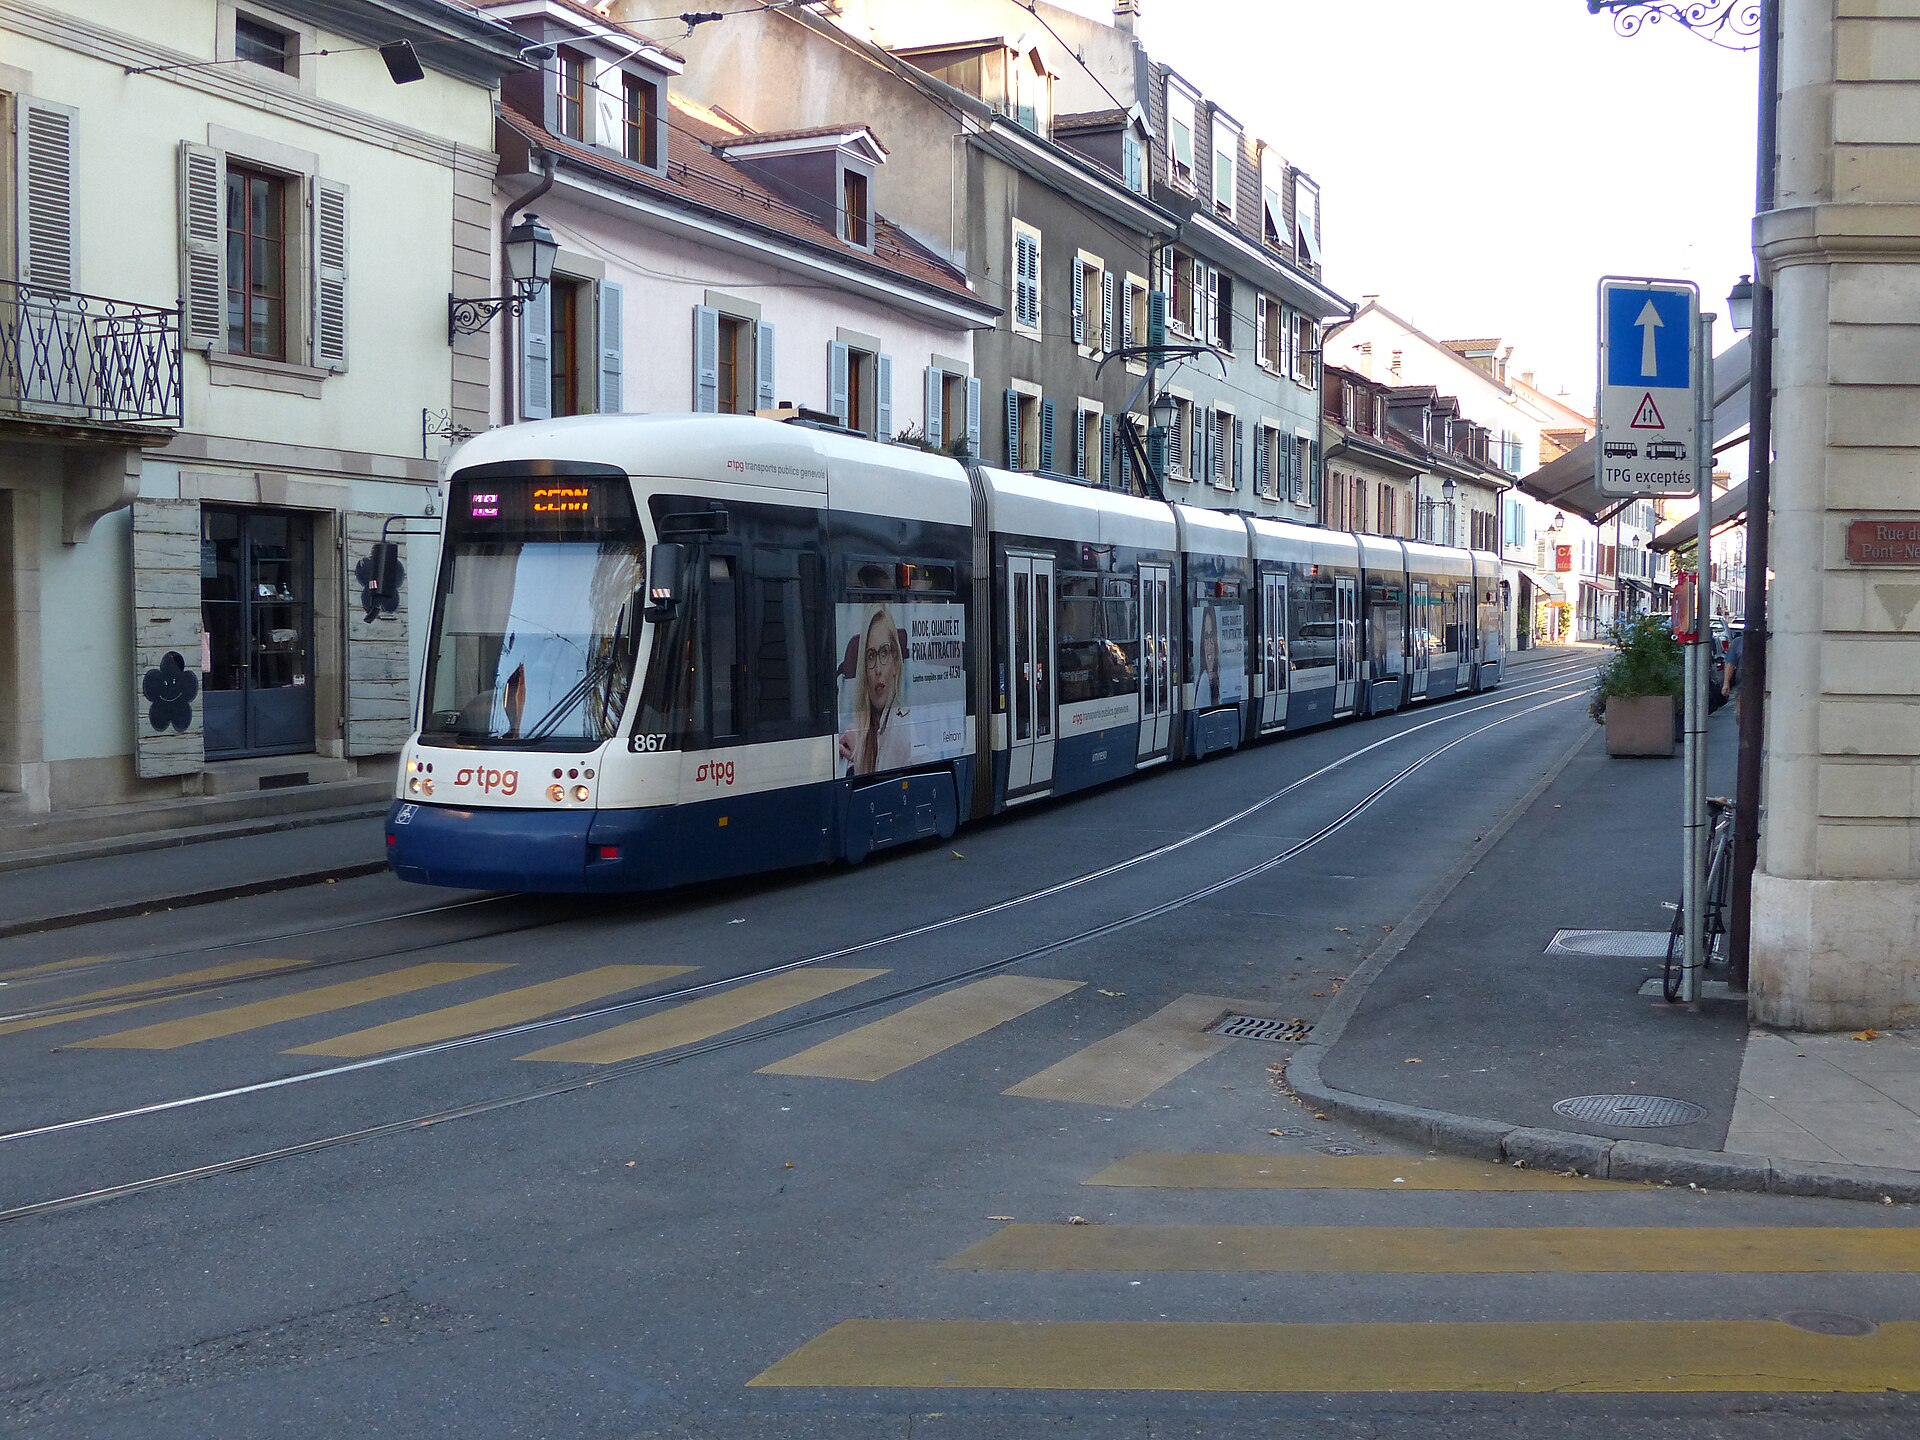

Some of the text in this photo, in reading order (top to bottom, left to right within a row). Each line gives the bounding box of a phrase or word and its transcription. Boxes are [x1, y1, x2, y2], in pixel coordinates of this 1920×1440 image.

[1606, 468, 1691, 486] TPG exceptés
[534, 488, 589, 511] CERN
[1877, 526, 1905, 541] Rue
[912, 616, 960, 639] MODE, QUALITÉ ET
[912, 640, 961, 661] PRIX ATTRACTIFS
[634, 733, 667, 751] 867
